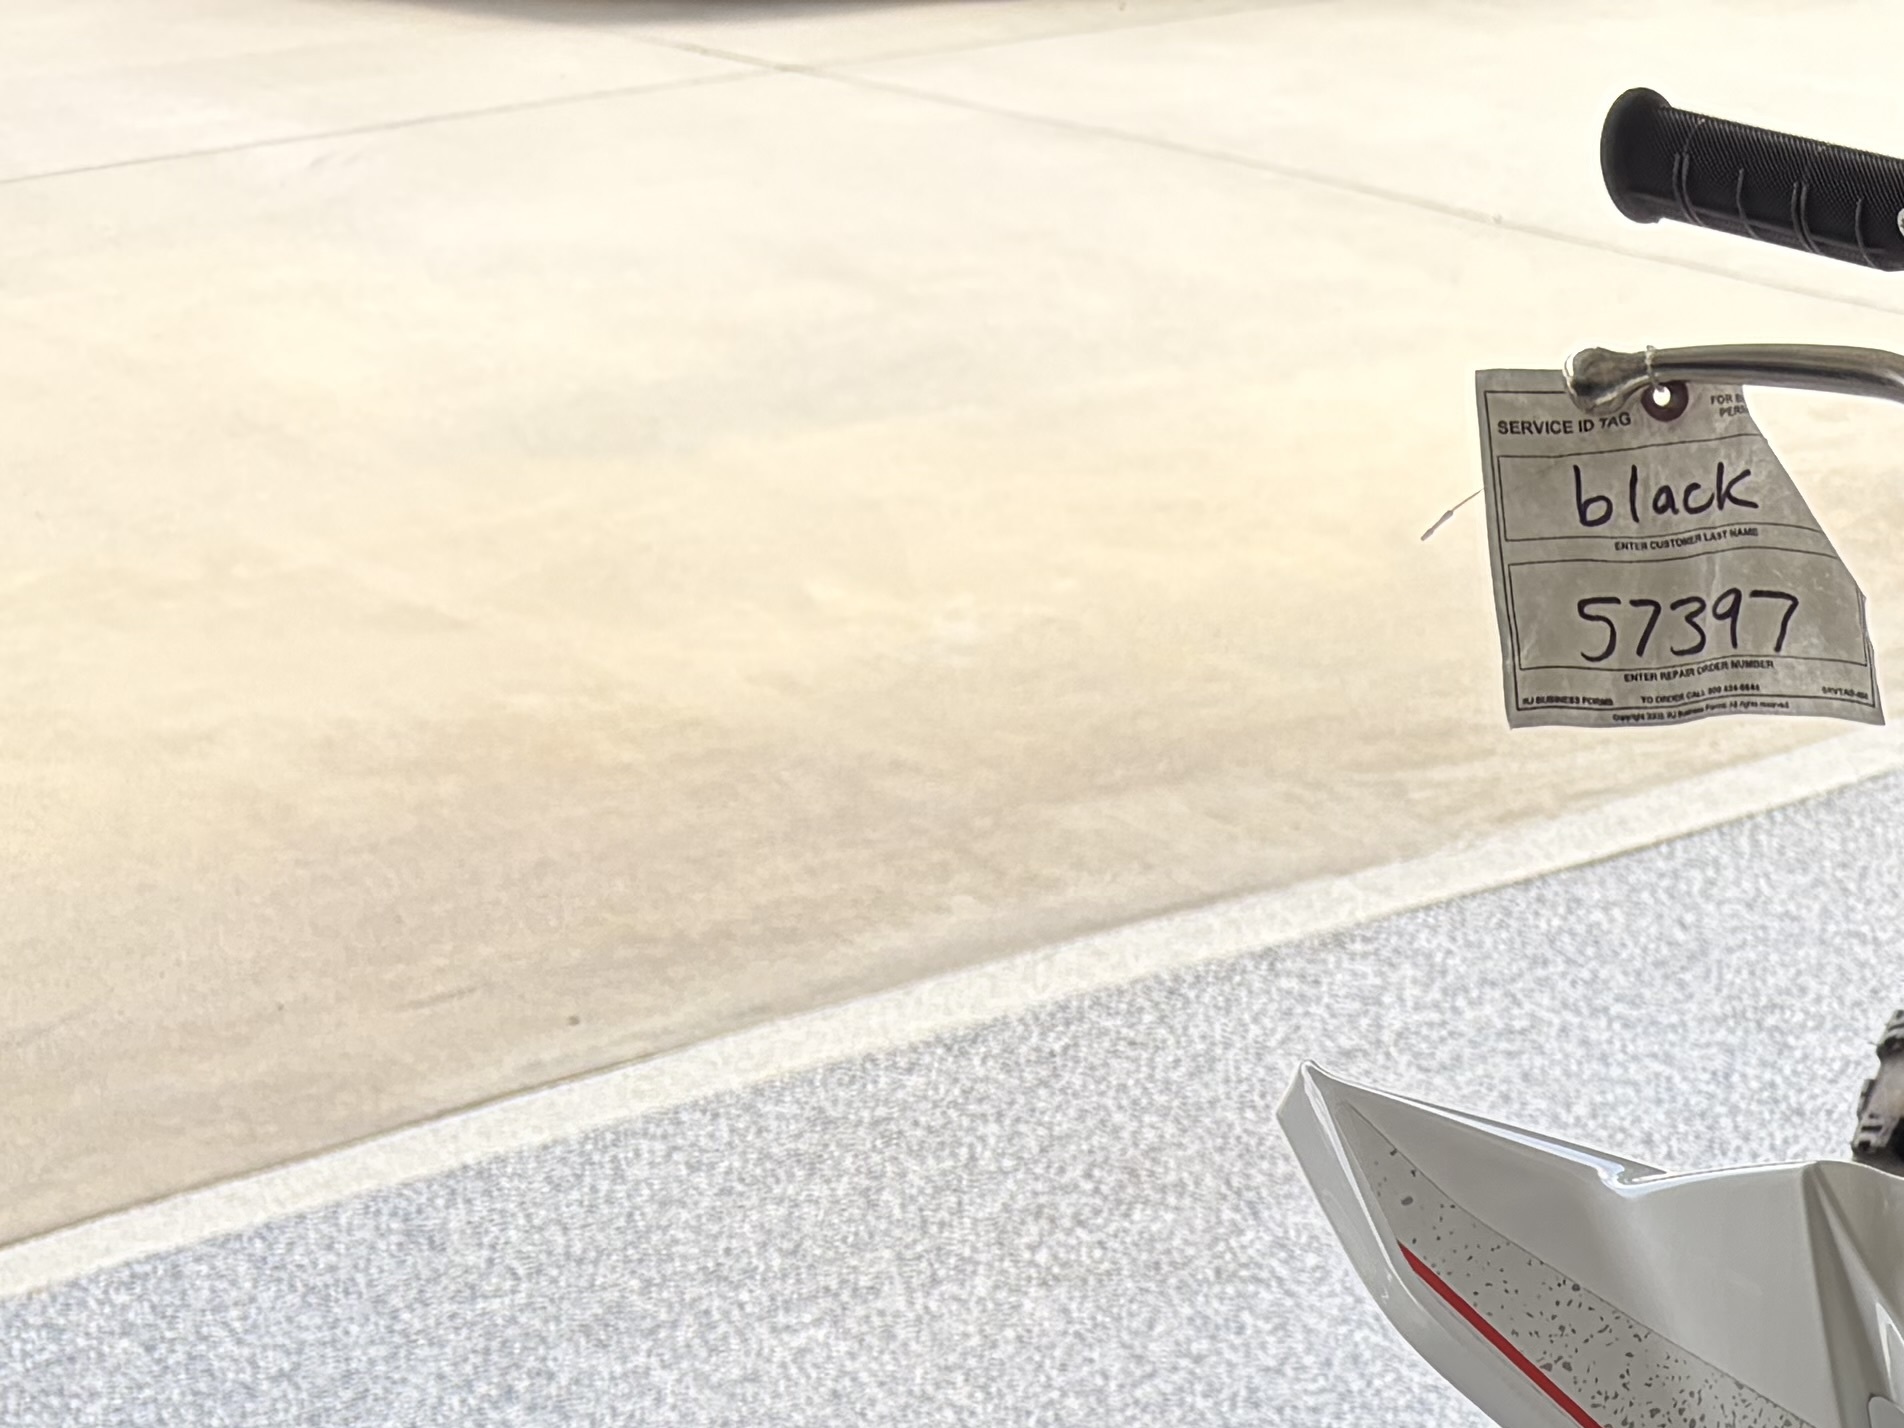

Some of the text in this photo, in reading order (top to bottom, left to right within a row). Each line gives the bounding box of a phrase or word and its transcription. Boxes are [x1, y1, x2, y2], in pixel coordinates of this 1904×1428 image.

[1497, 411, 1632, 435] SERVICE ID TAG
[1573, 461, 1759, 527] black
[1614, 527, 1759, 551] ENTER CUSTOMER LAST NAME
[1577, 587, 1799, 662] 57397
[1624, 659, 1775, 683] ENTER REPAIR ORDER NUMBER
